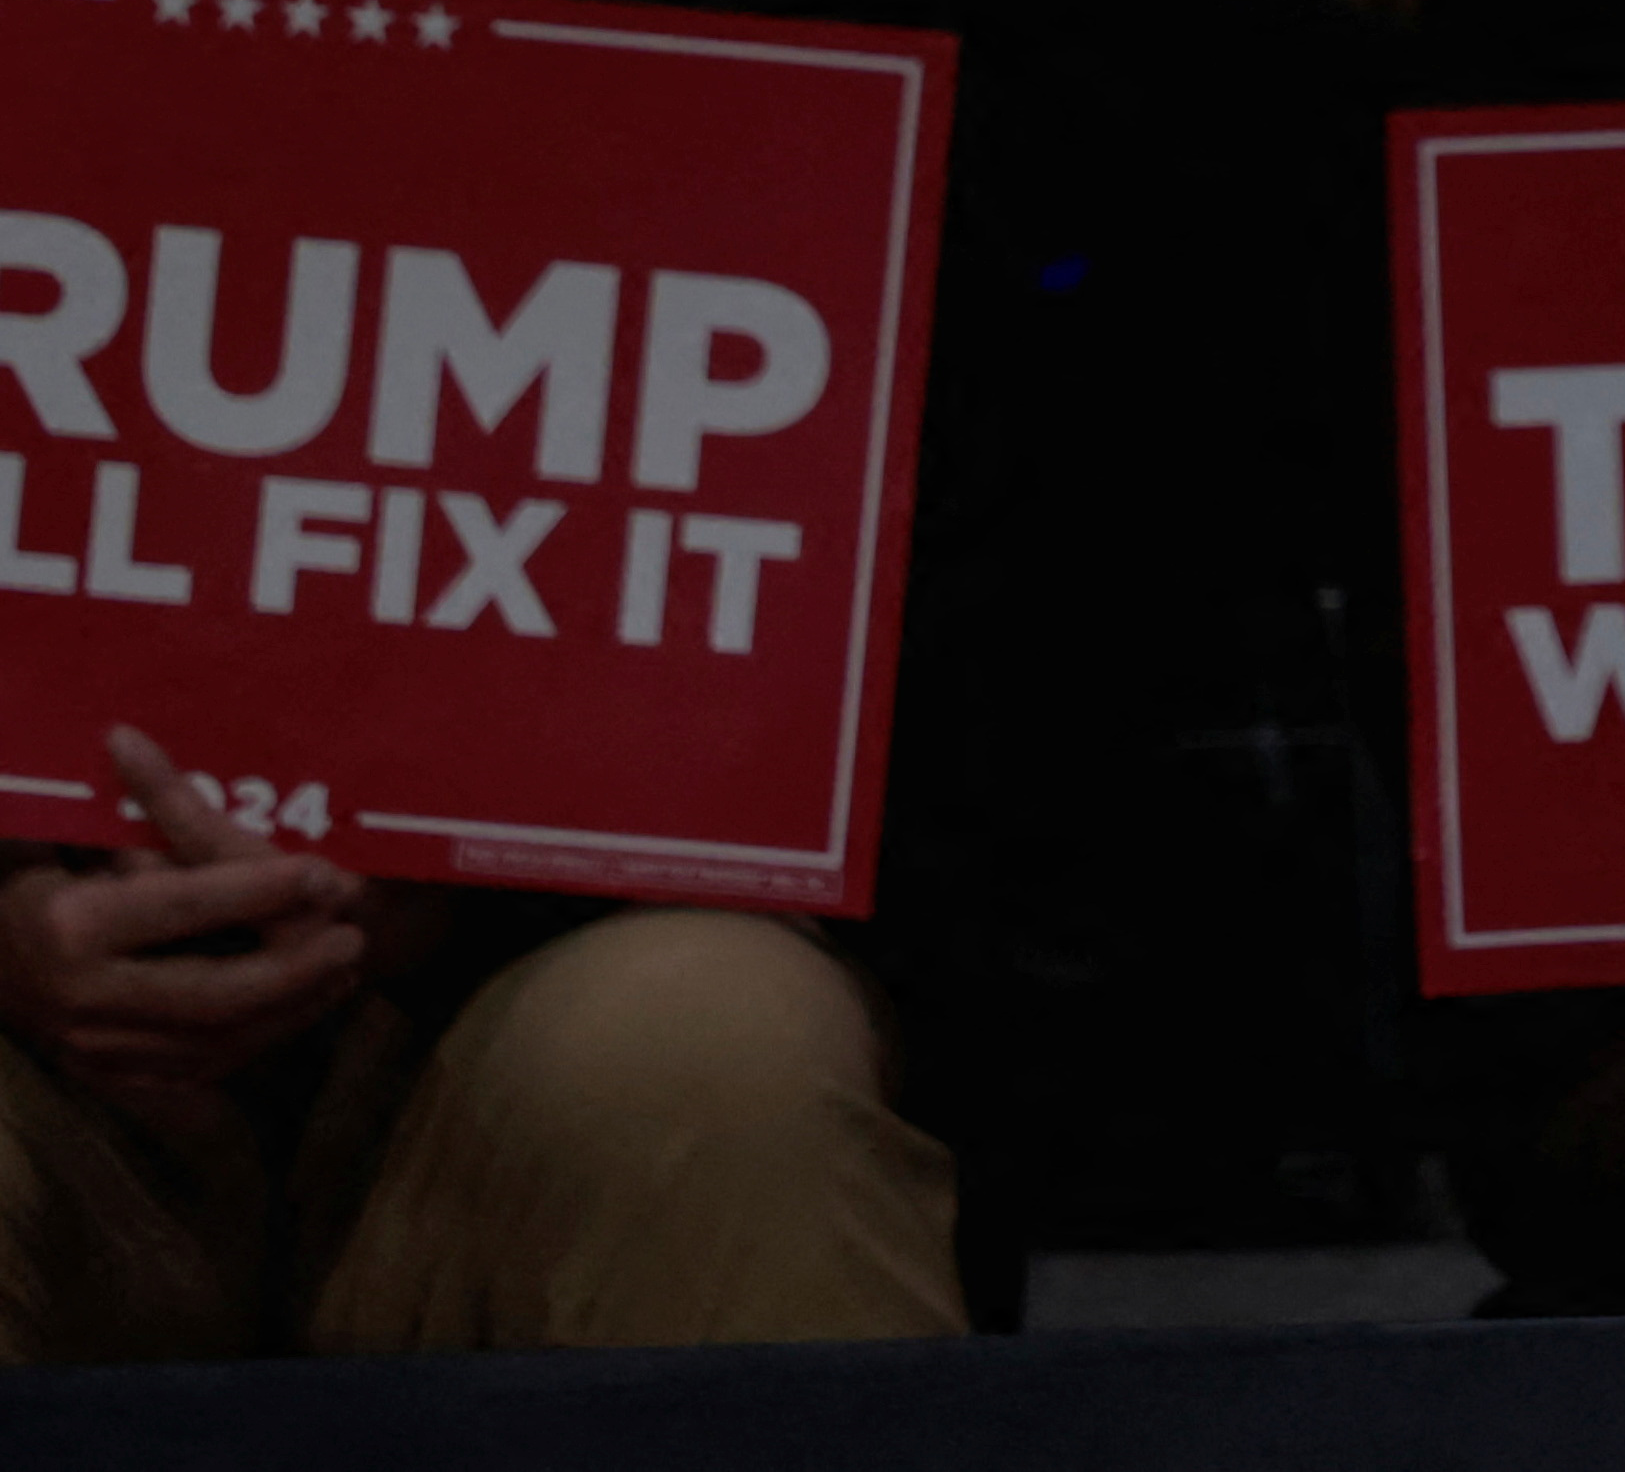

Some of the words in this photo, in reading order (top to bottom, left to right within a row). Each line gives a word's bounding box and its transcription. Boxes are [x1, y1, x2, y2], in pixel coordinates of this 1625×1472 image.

[0, 208, 832, 493] RUMP
[0, 449, 193, 606] LL
[249, 474, 568, 639] FIX
[616, 507, 804, 656] IT
[115, 769, 333, 833] 24
